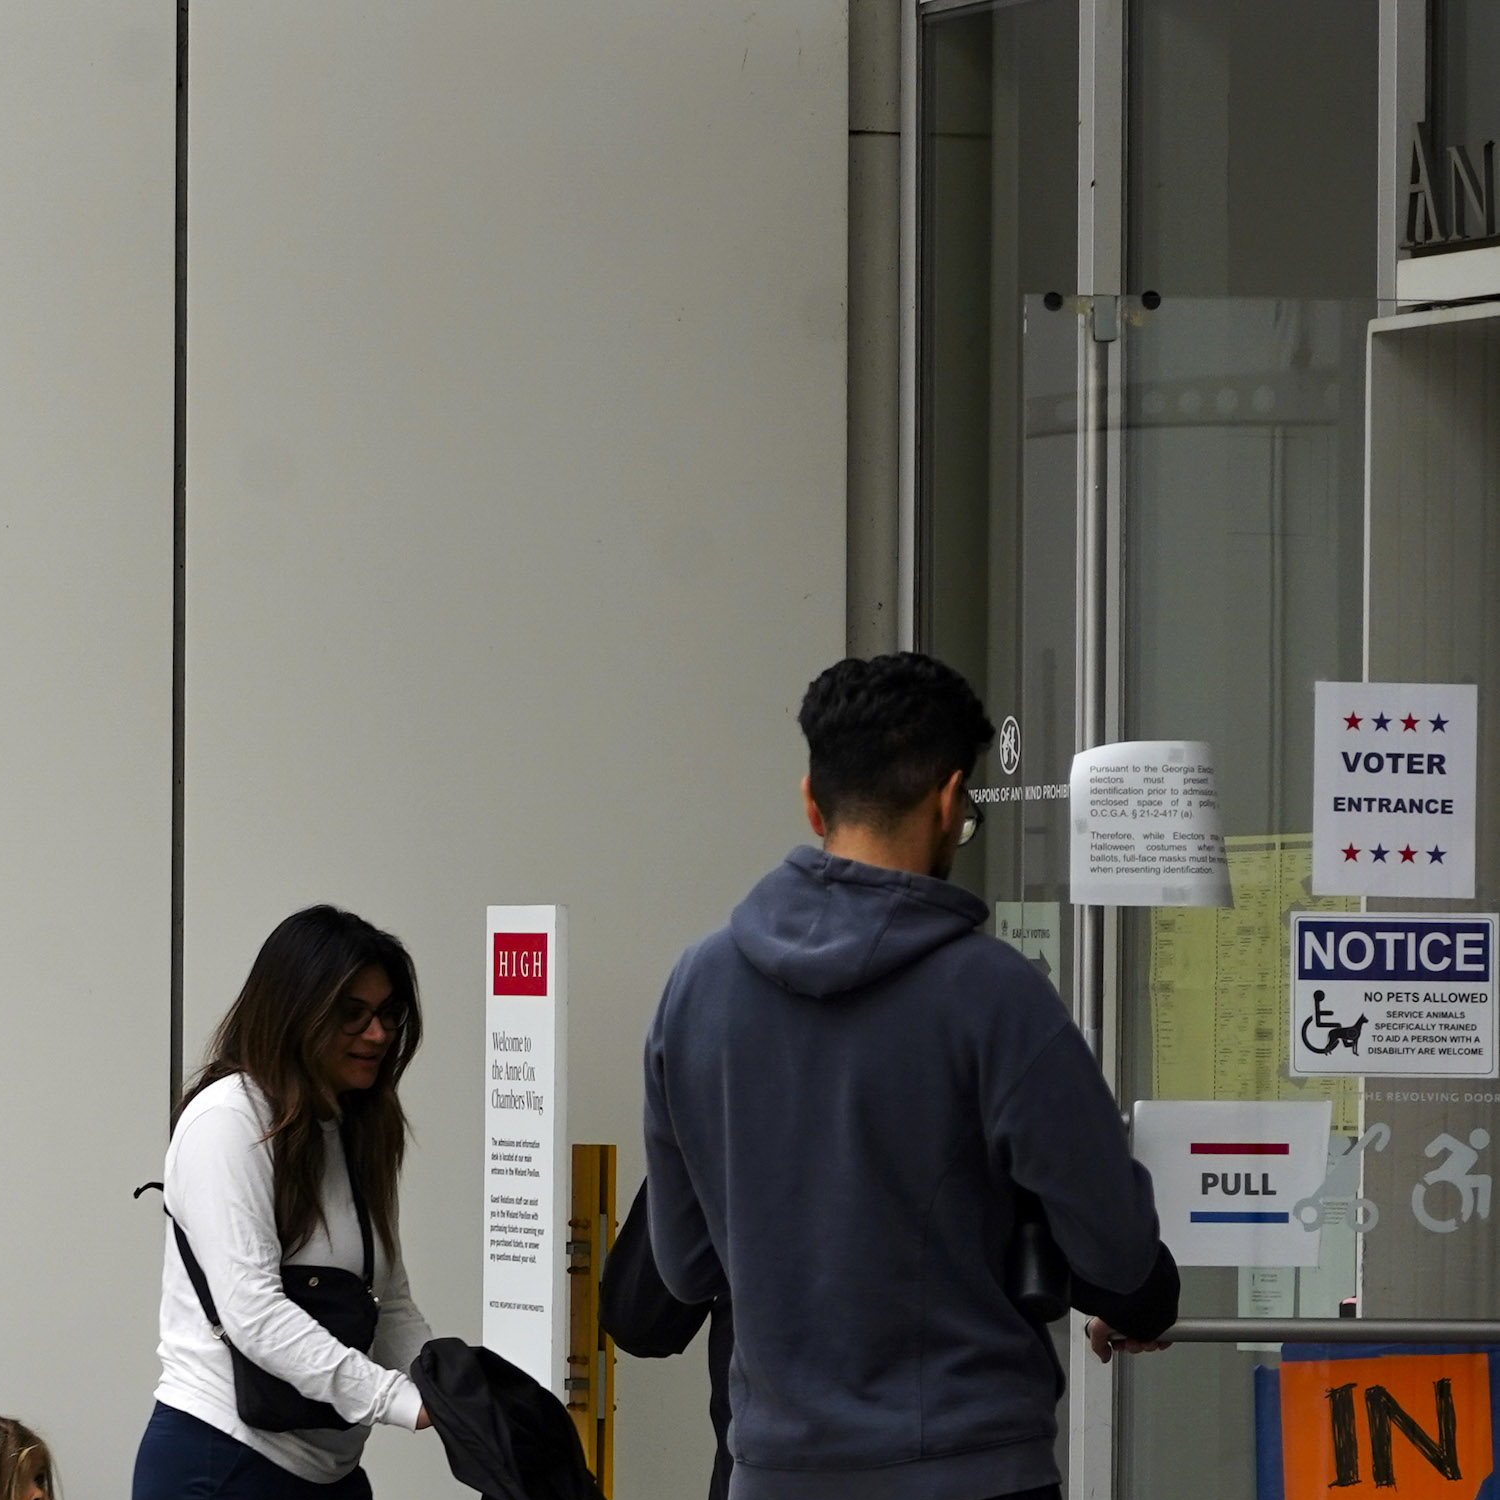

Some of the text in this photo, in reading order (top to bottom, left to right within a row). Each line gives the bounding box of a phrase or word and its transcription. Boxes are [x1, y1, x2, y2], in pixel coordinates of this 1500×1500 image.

[1341, 751, 1447, 775] VOTER
[1089, 765, 1129, 773] Pursuant
[1132, 765, 1140, 773] to
[1144, 765, 1158, 773] the
[1162, 765, 1194, 775] Georgia
[1090, 776, 1124, 784] electors
[1001, 787, 1010, 802] OF
[1010, 786, 1023, 801] ANY
[1025, 785, 1042, 800] KIND
[1090, 787, 1144, 795] identification
[1147, 788, 1167, 797] prior
[1090, 798, 1128, 806] enclosed
[1333, 796, 1454, 815] ENTRANCE
[1140, 809, 1178, 817] 21-2-417
[1090, 832, 1135, 840] Therefore,
[1142, 832, 1165, 840] while
[1173, 832, 1205, 840] Electors
[1090, 843, 1135, 851] Halloween
[1146, 843, 1187, 851] costumes
[1090, 854, 1121, 862] ballots,
[1123, 854, 1156, 862] full-face
[1159, 854, 1186, 862] masks
[1116, 866, 1161, 875] presenting
[1304, 931, 1485, 972] NOTICE
[499, 951, 542, 977] HIGH
[1364, 992, 1488, 1003] NO PETS ALLOWED
[1386, 1011, 1465, 1019] SERVICE ANIMALS
[1375, 1023, 1477, 1031] SPECIFICALLY TRAINED
[492, 1031, 531, 1052] Welcome to
[1385, 1035, 1400, 1043] AID
[1402, 1035, 1409, 1043] A
[1411, 1035, 1448, 1043] PERSON
[1368, 1047, 1416, 1055] DISABILITY
[492, 1059, 536, 1081] the Anne Cox
[492, 1088, 544, 1116] Chambers Wing
[1387, 1092, 1459, 1103] REVOLVING
[1202, 1173, 1277, 1195] PULL
[1324, 1377, 1463, 1493] IN
